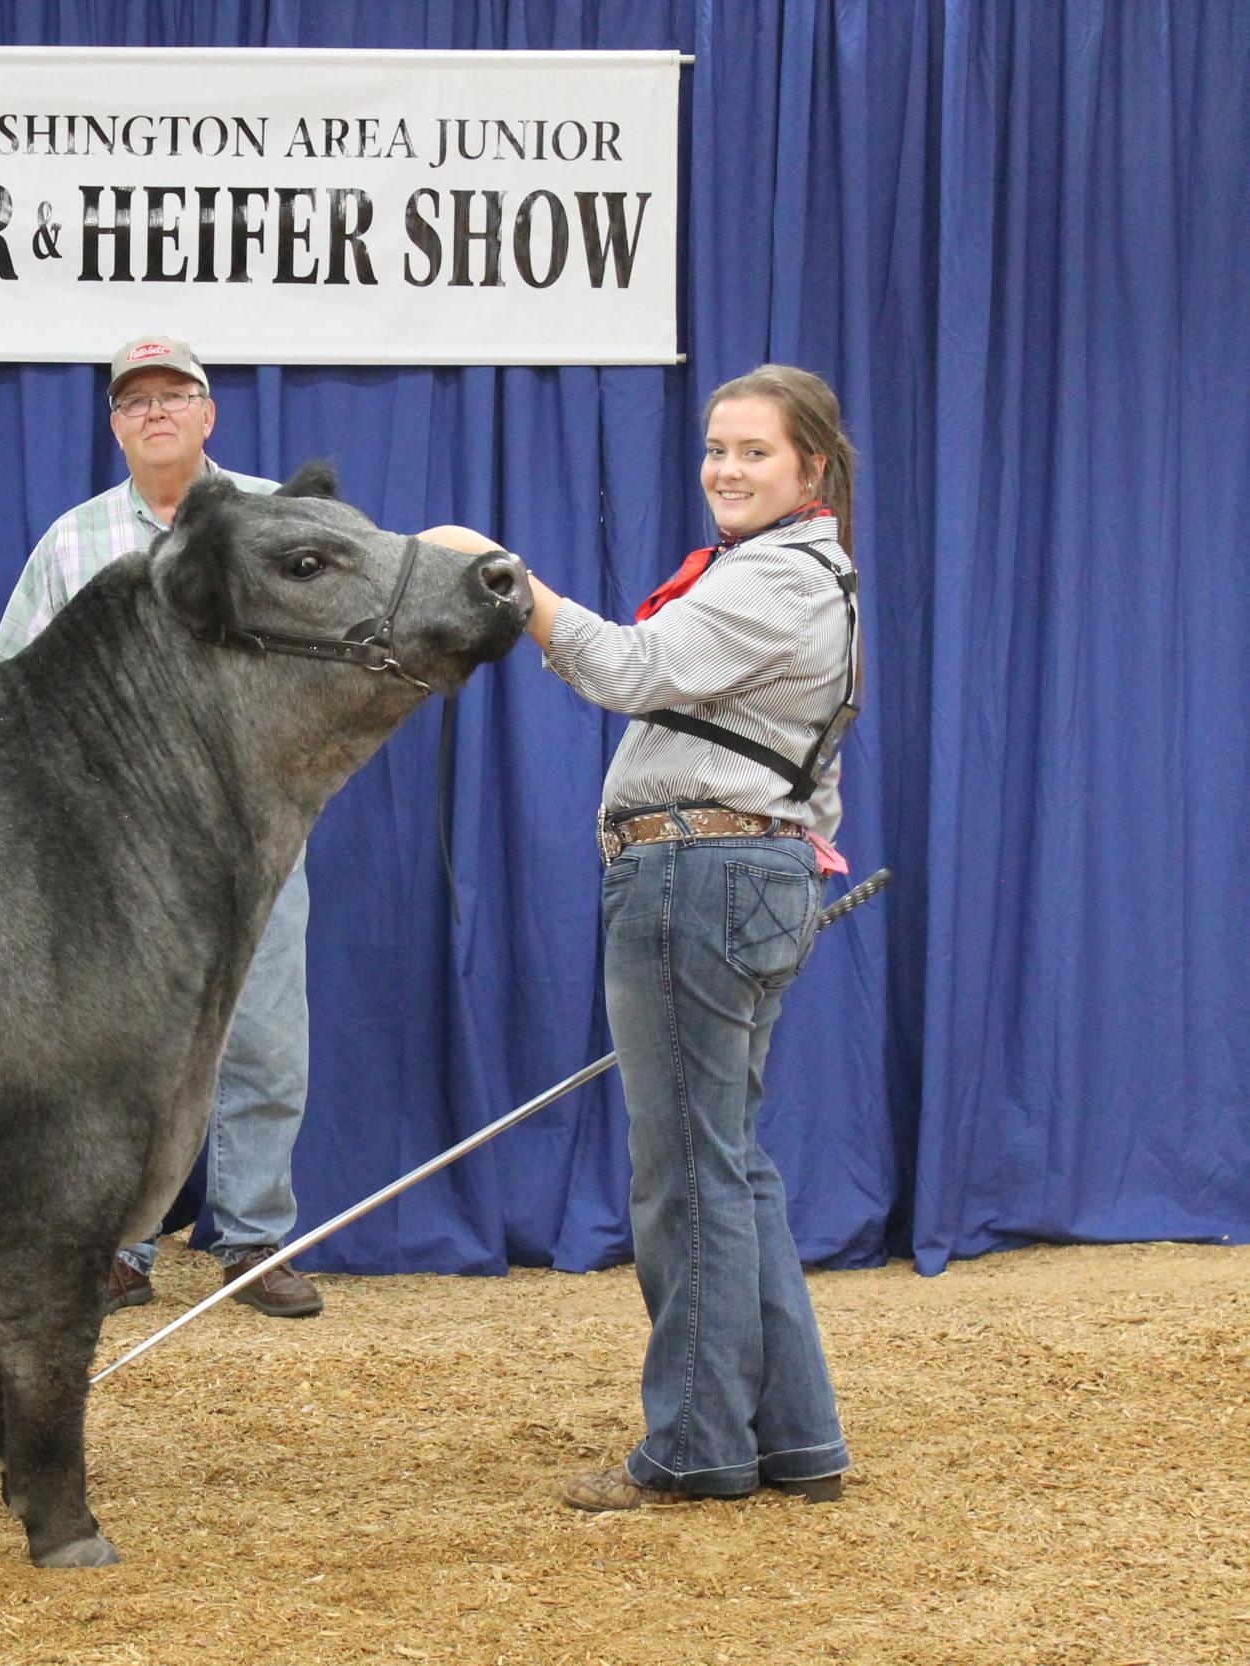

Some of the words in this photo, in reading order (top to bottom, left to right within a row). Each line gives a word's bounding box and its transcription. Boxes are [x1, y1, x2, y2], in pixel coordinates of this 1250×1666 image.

[286, 118, 417, 160] AREA
[428, 119, 623, 168] JUNIOR
[32, 202, 62, 260] &
[77, 186, 377, 284] HEIFER
[403, 187, 652, 289] SHOW
